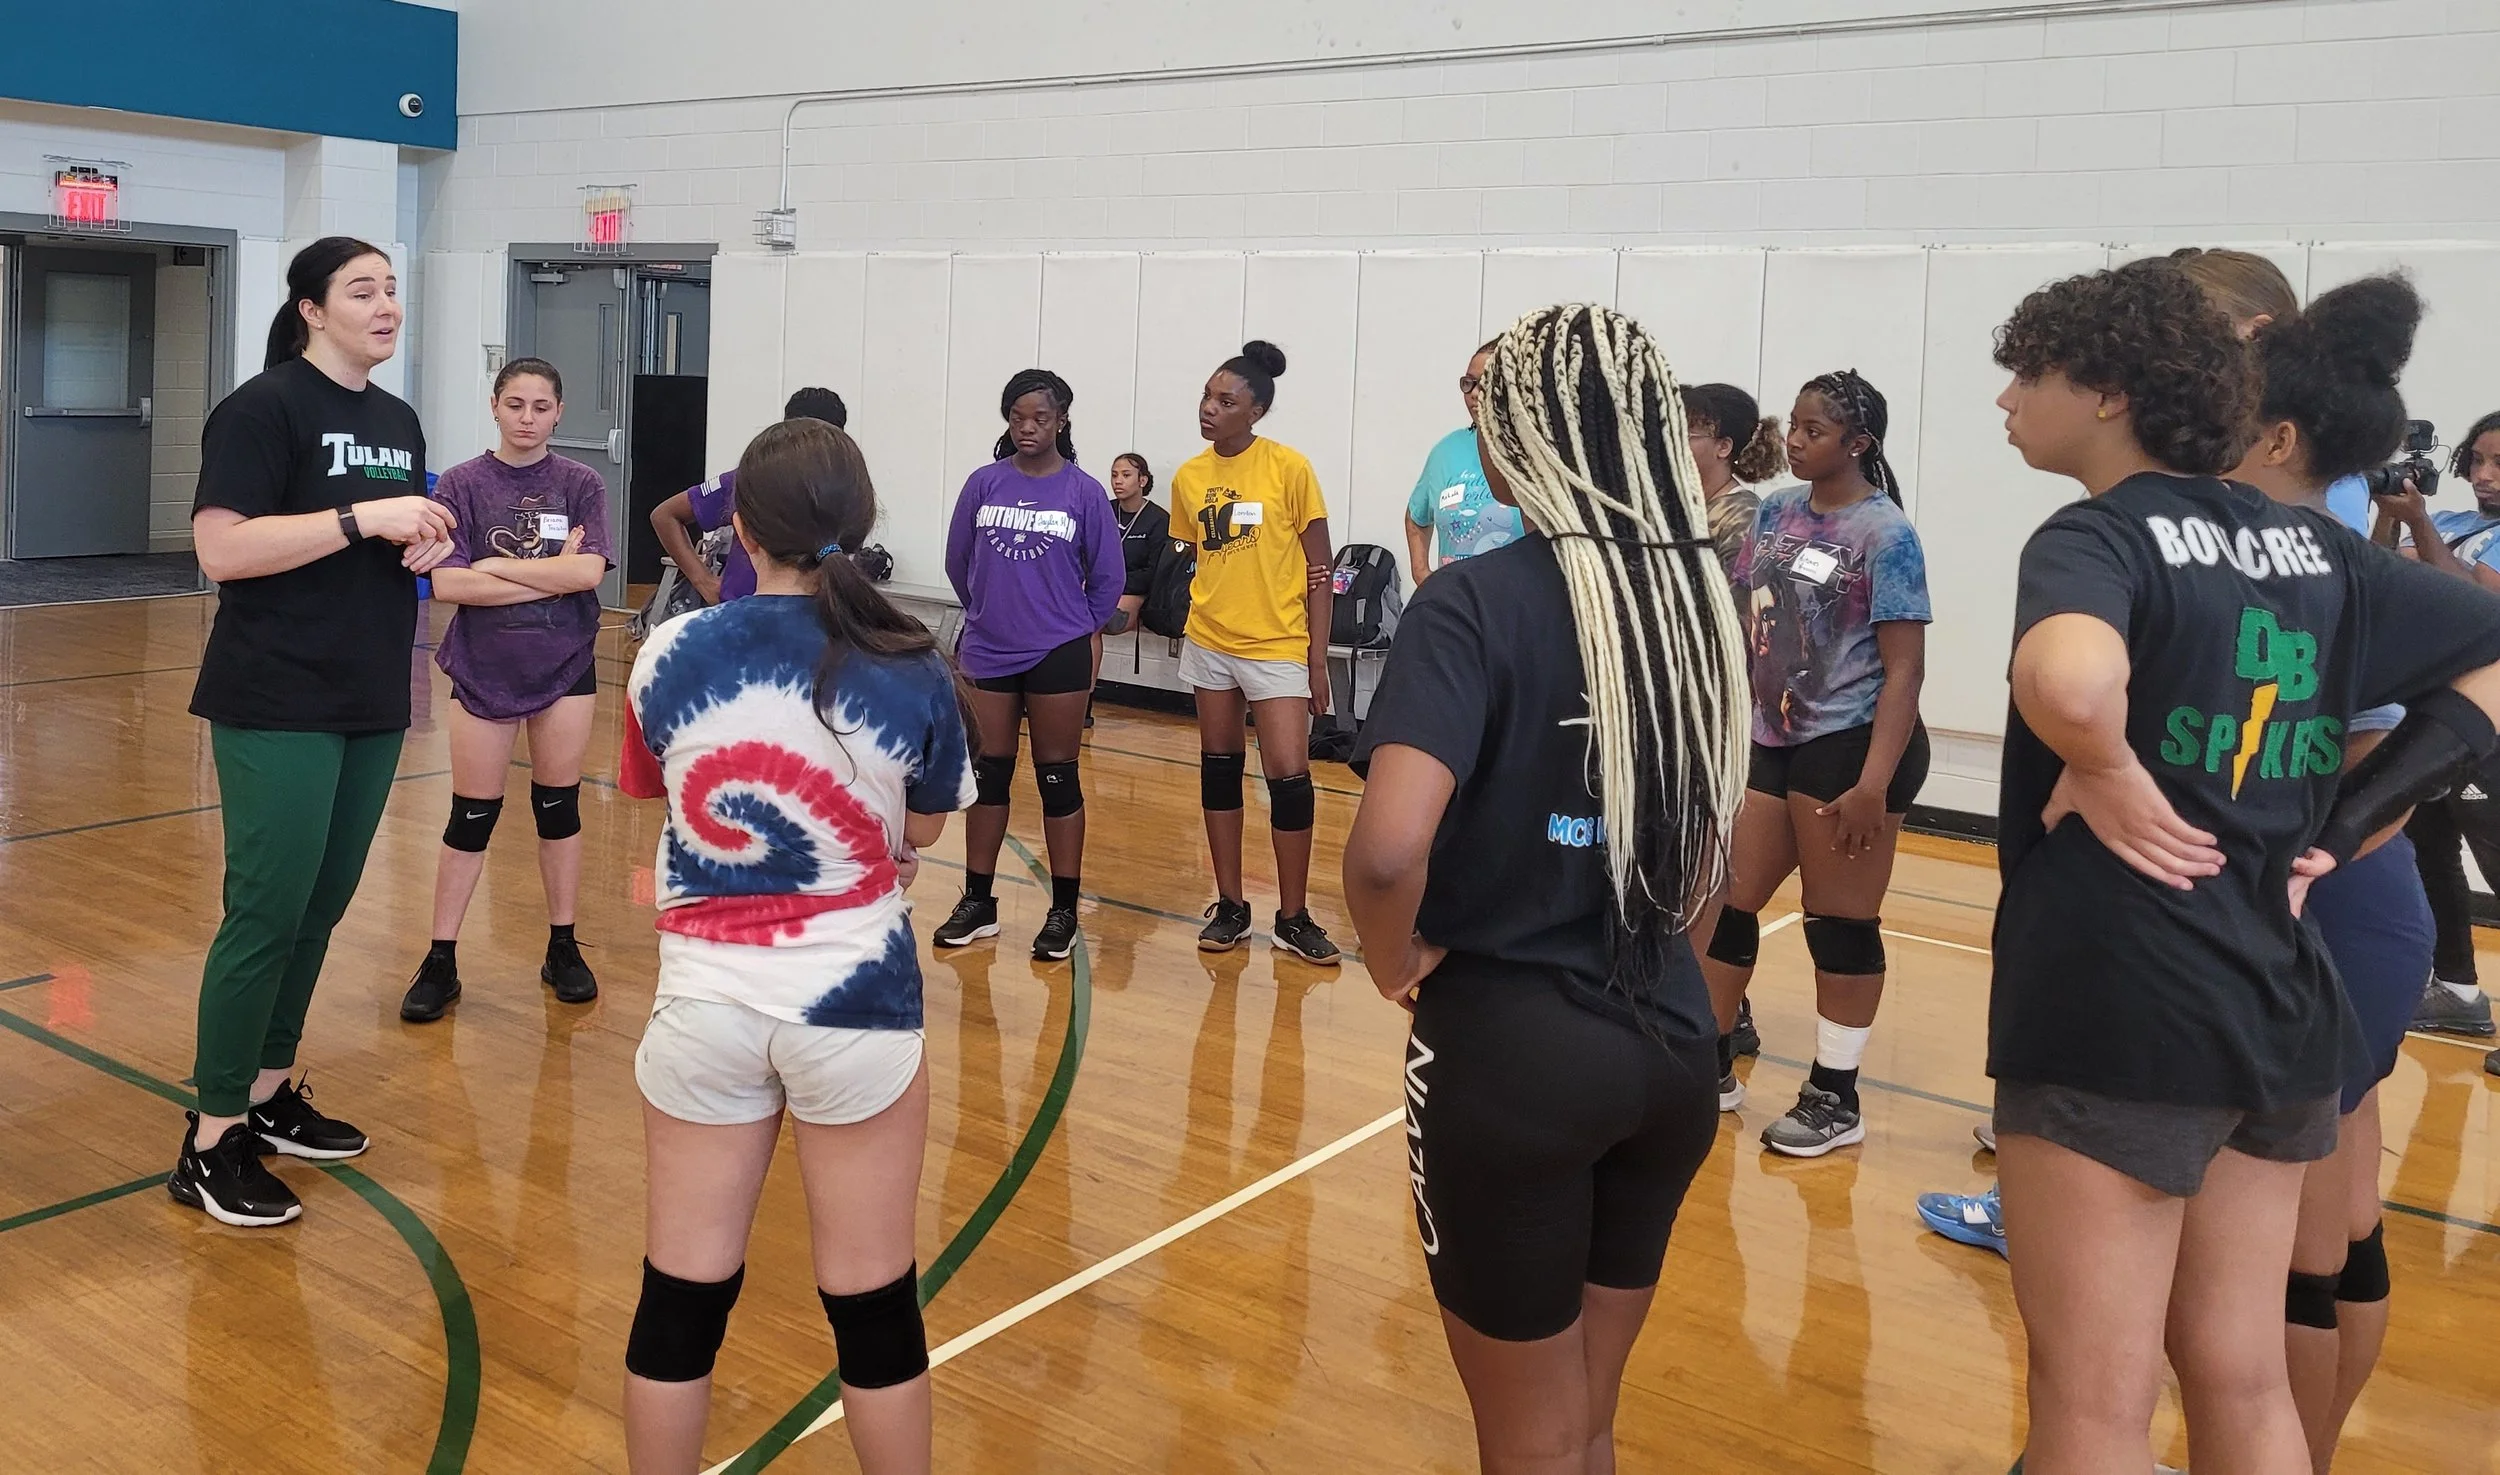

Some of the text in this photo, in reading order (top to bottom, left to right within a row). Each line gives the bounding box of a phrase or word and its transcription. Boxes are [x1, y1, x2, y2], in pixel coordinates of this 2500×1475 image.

[67, 191, 107, 222] EXIT
[594, 213, 617, 242] EXIT
[364, 466, 409, 481] VOLLEYBALL
[986, 529, 1054, 561] BASKETBALL
[2235, 607, 2319, 701] DB
[1404, 1032, 1441, 1256] CALVIN
